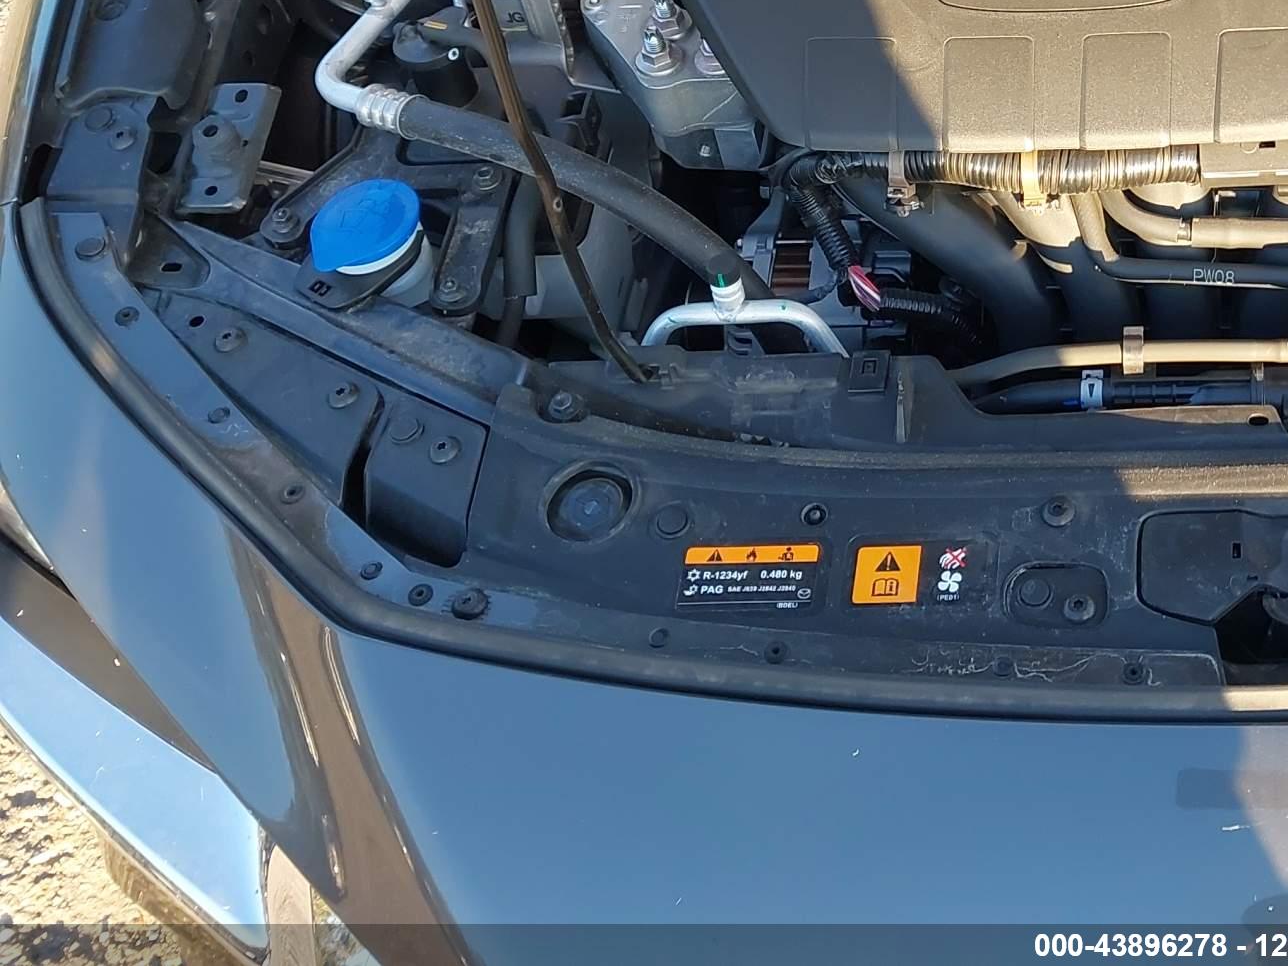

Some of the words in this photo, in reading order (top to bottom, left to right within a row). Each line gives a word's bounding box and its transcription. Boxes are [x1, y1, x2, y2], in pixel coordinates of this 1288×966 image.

[702, 570, 749, 581] R-1234yf
[760, 570, 788, 579] 0.480
[790, 569, 803, 580] kg
[700, 585, 724, 595] PAG
